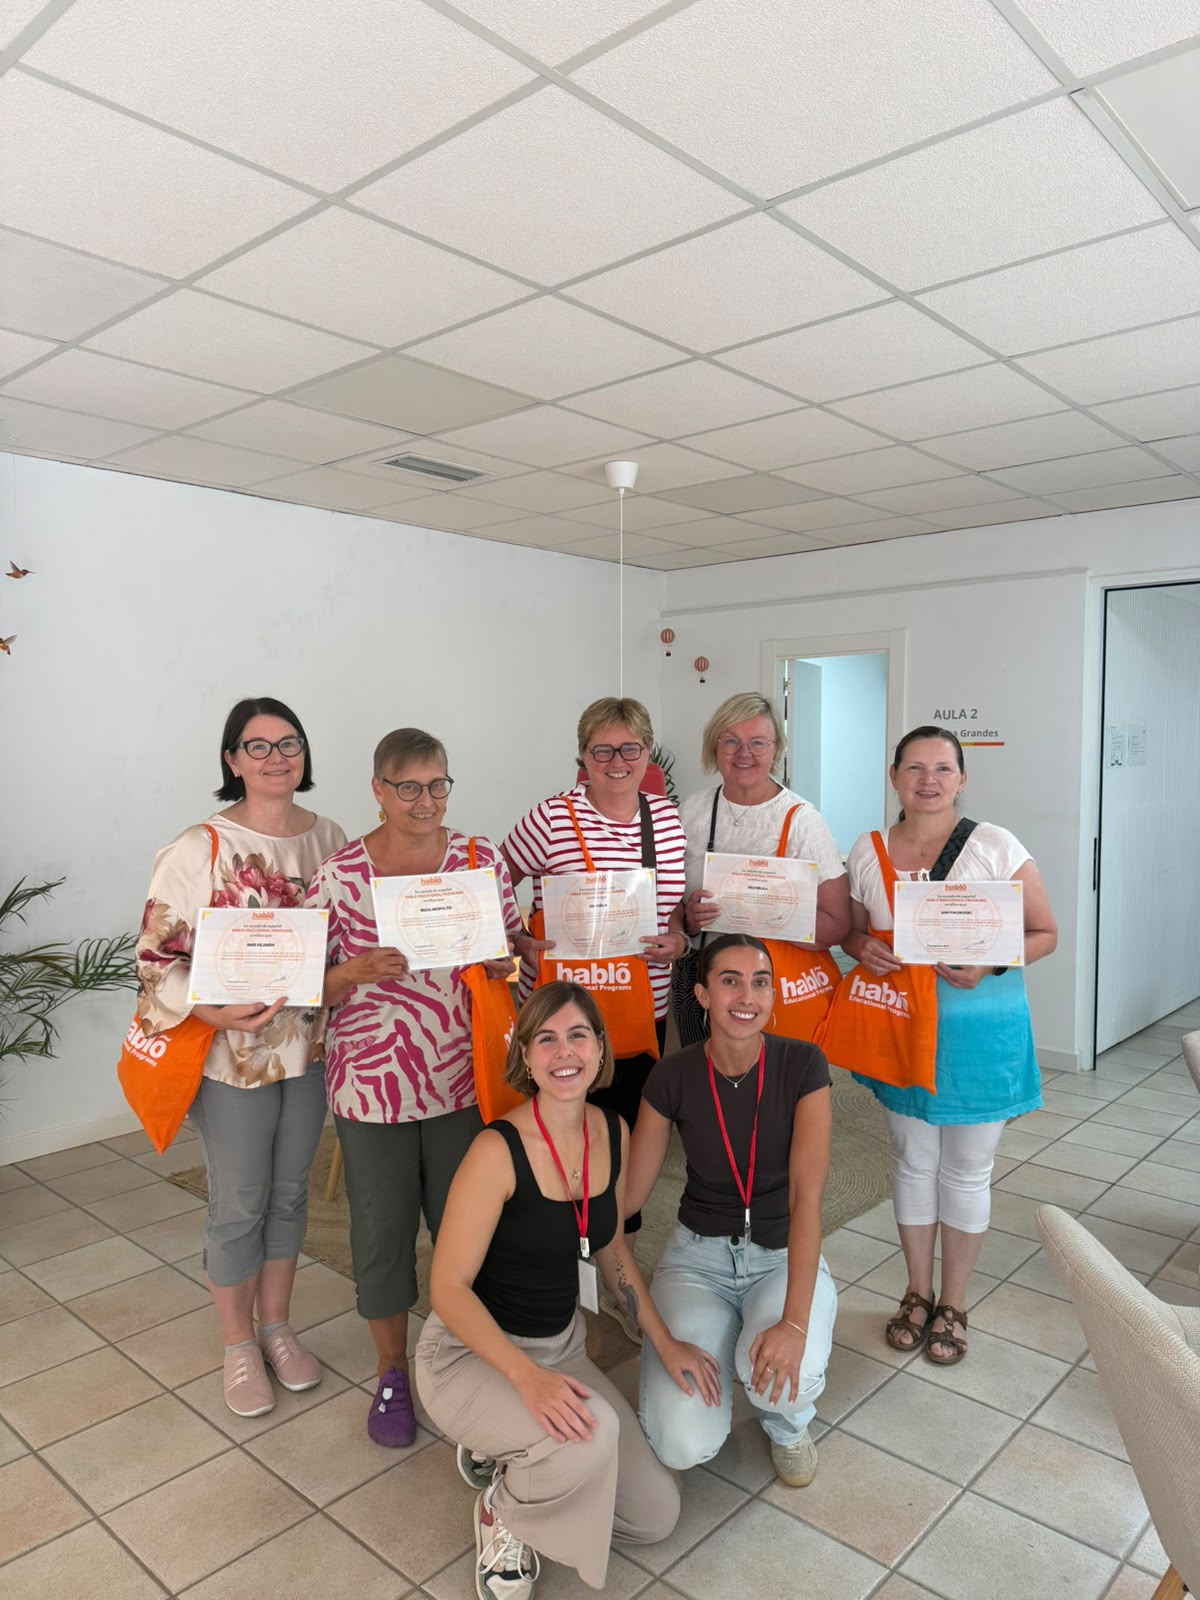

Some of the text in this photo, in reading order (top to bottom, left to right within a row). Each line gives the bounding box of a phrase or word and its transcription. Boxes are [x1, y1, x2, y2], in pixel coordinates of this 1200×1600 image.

[933, 708, 978, 720] AULA 2
[960, 729, 998, 738] Grandes
[848, 995, 886, 1010] Educational
